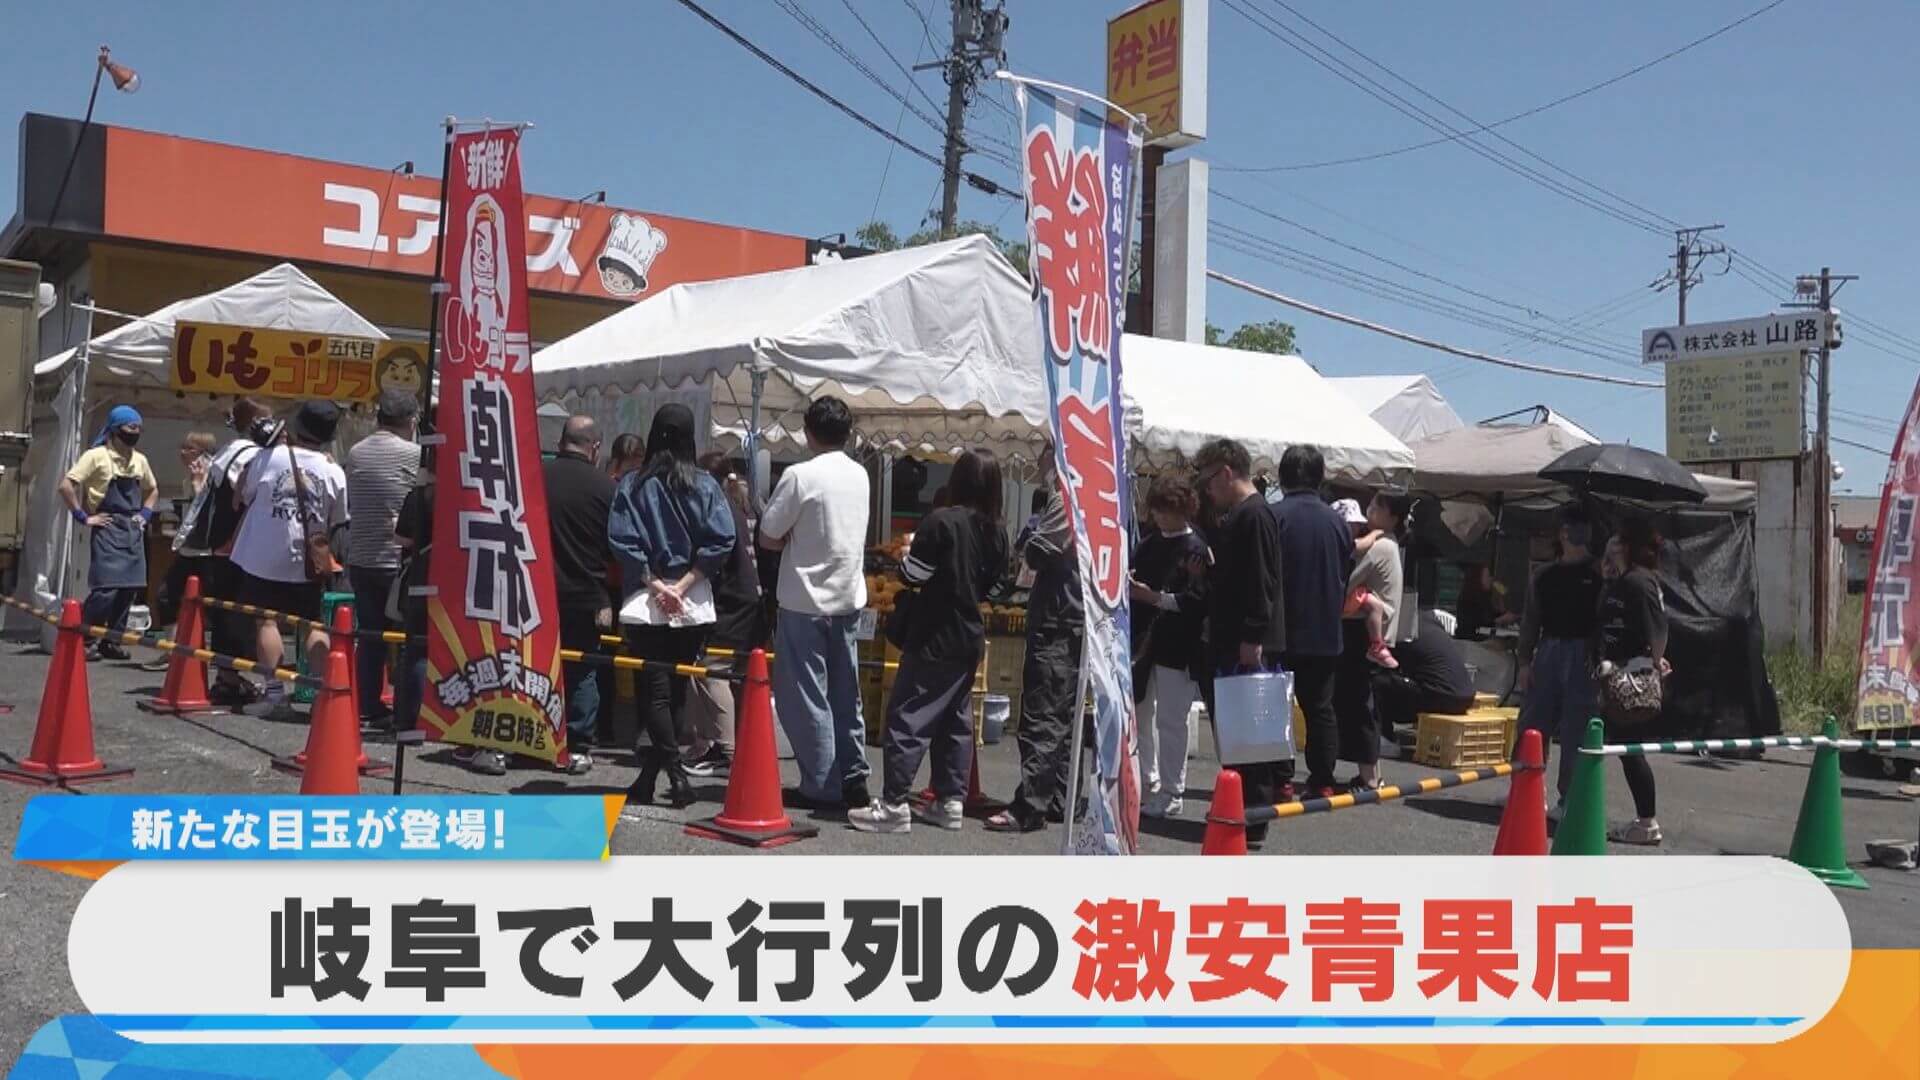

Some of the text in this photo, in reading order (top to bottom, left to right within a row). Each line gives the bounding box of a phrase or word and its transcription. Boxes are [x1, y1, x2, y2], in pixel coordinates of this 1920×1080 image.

[1111, 17, 1178, 94] 弁当
[467, 139, 504, 190] 新鮮
[329, 341, 374, 359] 五代目
[1683, 318, 1819, 352] 株式会社 山路
[460, 372, 542, 638] 朝市
[438, 649, 564, 733] 毎週末開催
